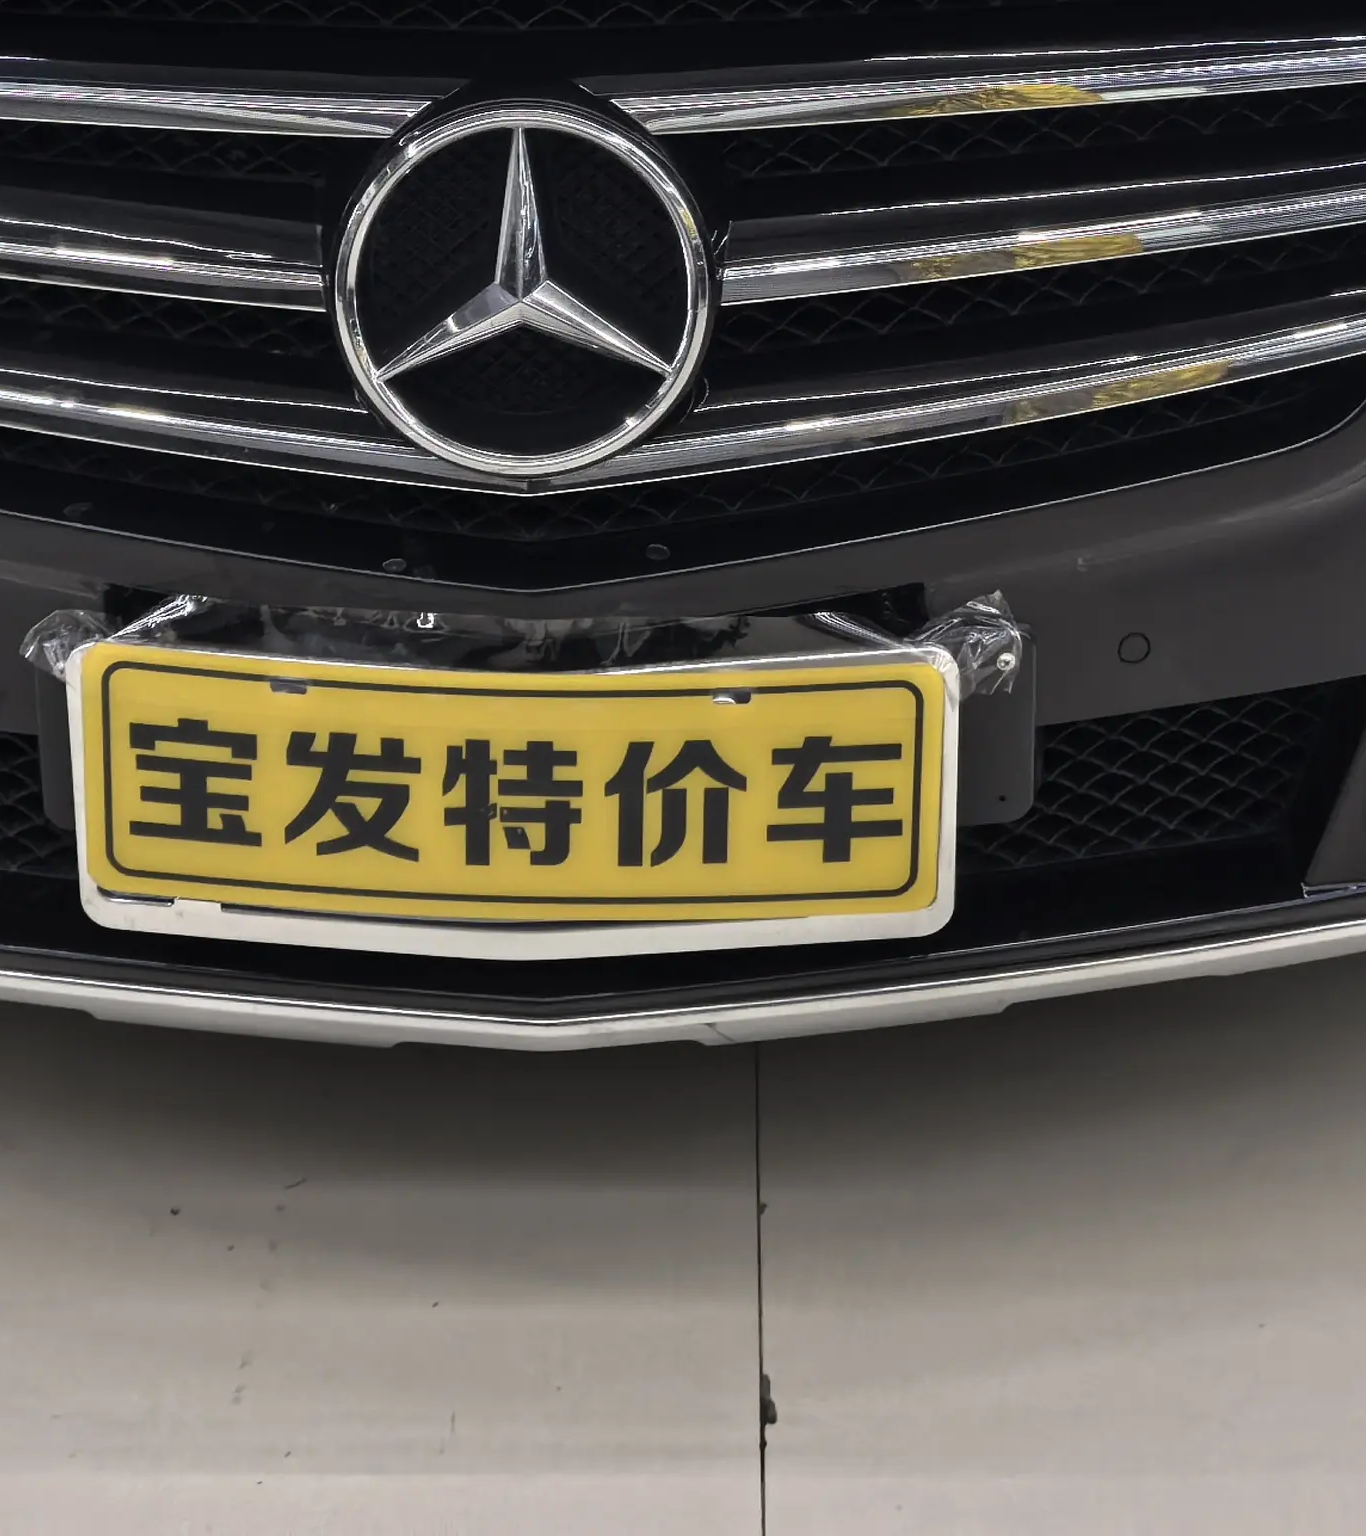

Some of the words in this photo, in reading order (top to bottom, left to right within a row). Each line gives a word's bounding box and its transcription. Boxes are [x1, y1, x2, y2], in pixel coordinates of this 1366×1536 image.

[126, 717, 905, 867] 宝发特价车
